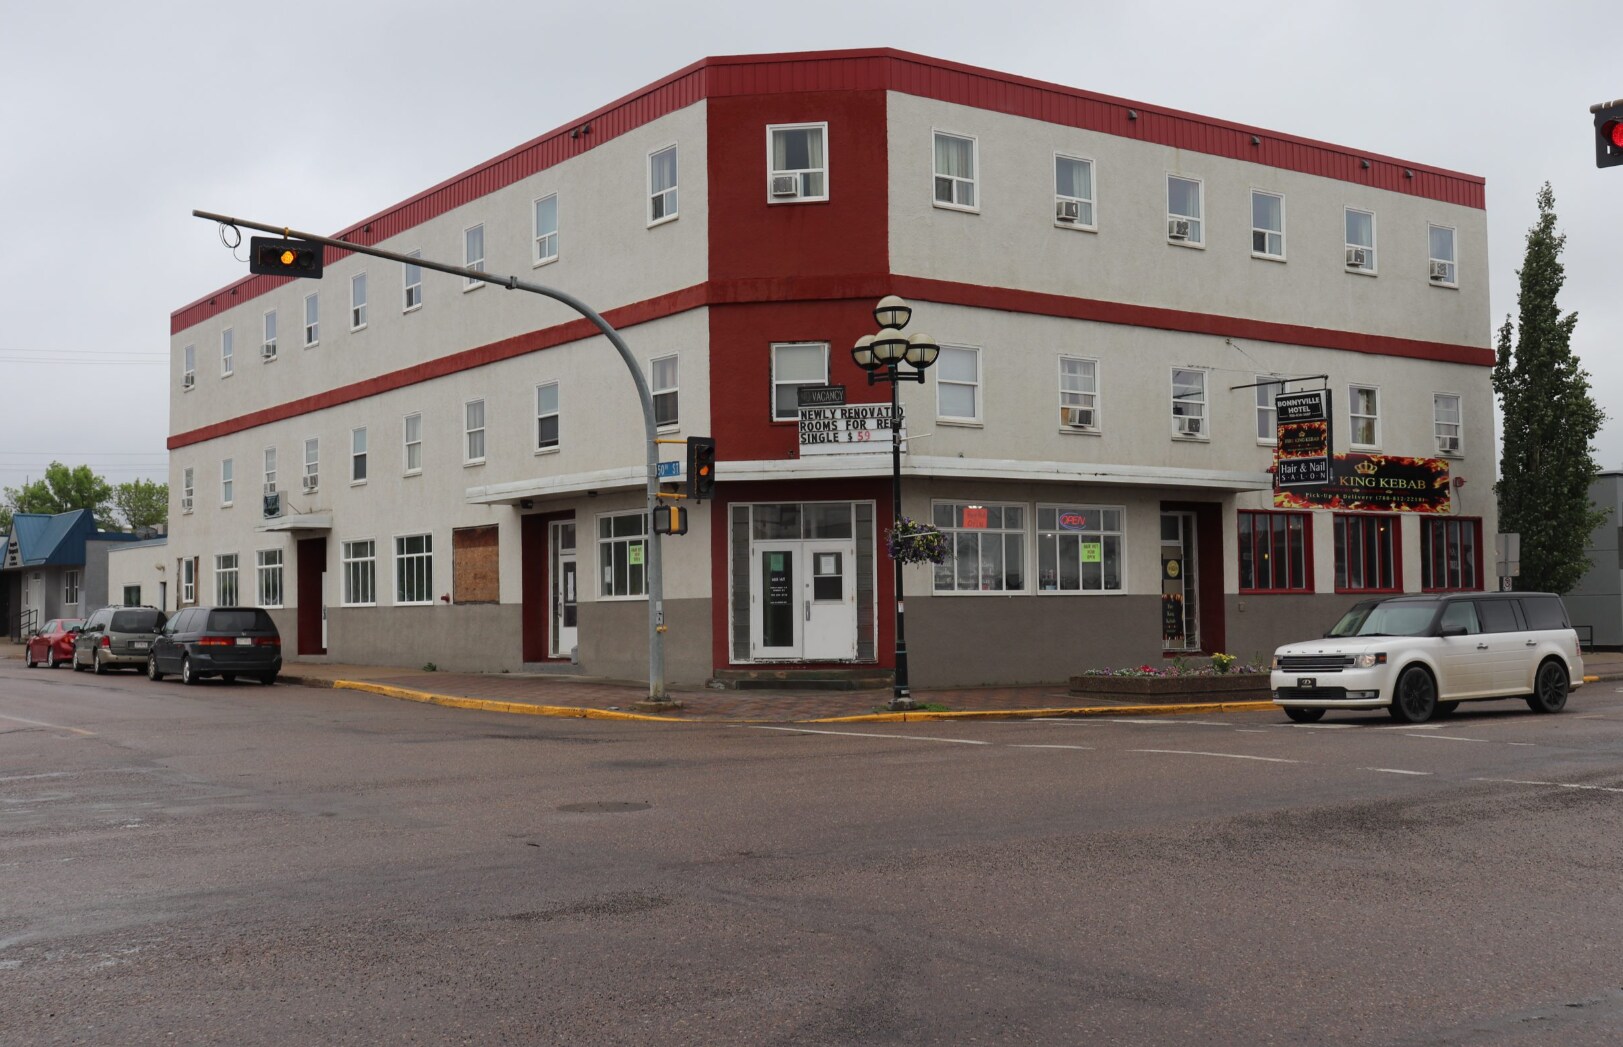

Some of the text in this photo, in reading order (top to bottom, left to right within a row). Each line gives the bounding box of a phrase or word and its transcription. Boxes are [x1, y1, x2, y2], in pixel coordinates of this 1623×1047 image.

[812, 390, 844, 401] VACANCY
[1277, 396, 1320, 408] BONNYVILLE
[800, 407, 904, 420] NEWLY RENOVATD
[1288, 406, 1311, 414] HOTEL
[800, 419, 902, 431] ROOMS FOR RE
[800, 432, 839, 443] SINGLE
[857, 431, 871, 441] 59
[1281, 461, 1326, 474] Hair & Nail
[1339, 476, 1426, 490] KING KEBAB
[1342, 494, 1373, 502] Delivery
[1061, 515, 1086, 525] OPEN
